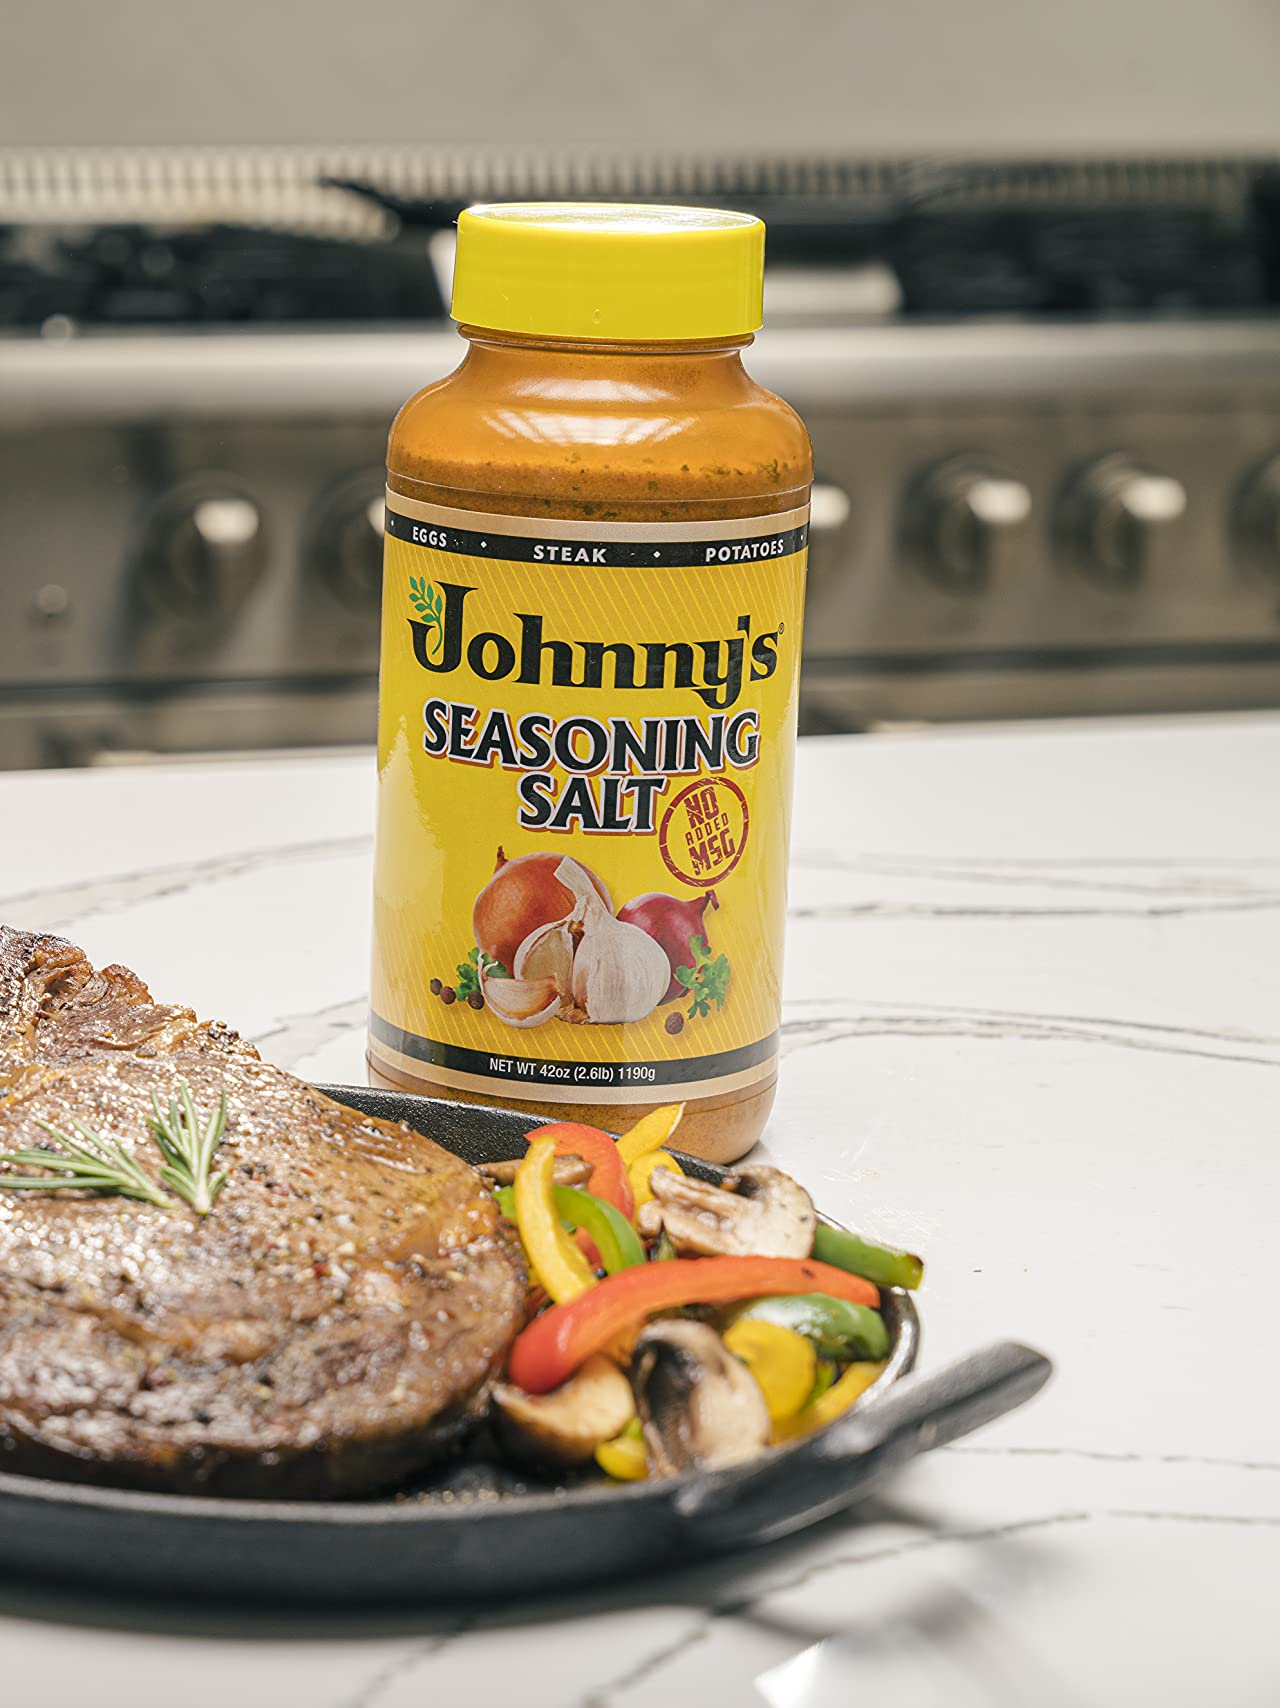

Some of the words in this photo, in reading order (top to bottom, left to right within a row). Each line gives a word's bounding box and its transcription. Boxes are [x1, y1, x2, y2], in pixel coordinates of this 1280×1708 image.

[412, 526, 447, 548] EGGS
[533, 545, 607, 563] STEAK
[705, 539, 784, 563] POTATOES
[407, 580, 779, 710] Johnny's
[422, 697, 761, 776] SEASONING
[517, 773, 669, 835] SALT
[683, 786, 720, 829] NO
[685, 812, 729, 846] ADDED
[688, 828, 736, 876] MSG
[489, 1057, 514, 1073] NET
[516, 1061, 537, 1076] WT
[539, 1064, 571, 1079] 42oz
[573, 1066, 614, 1083] (2.6lb)
[617, 1066, 656, 1082] 1190g
